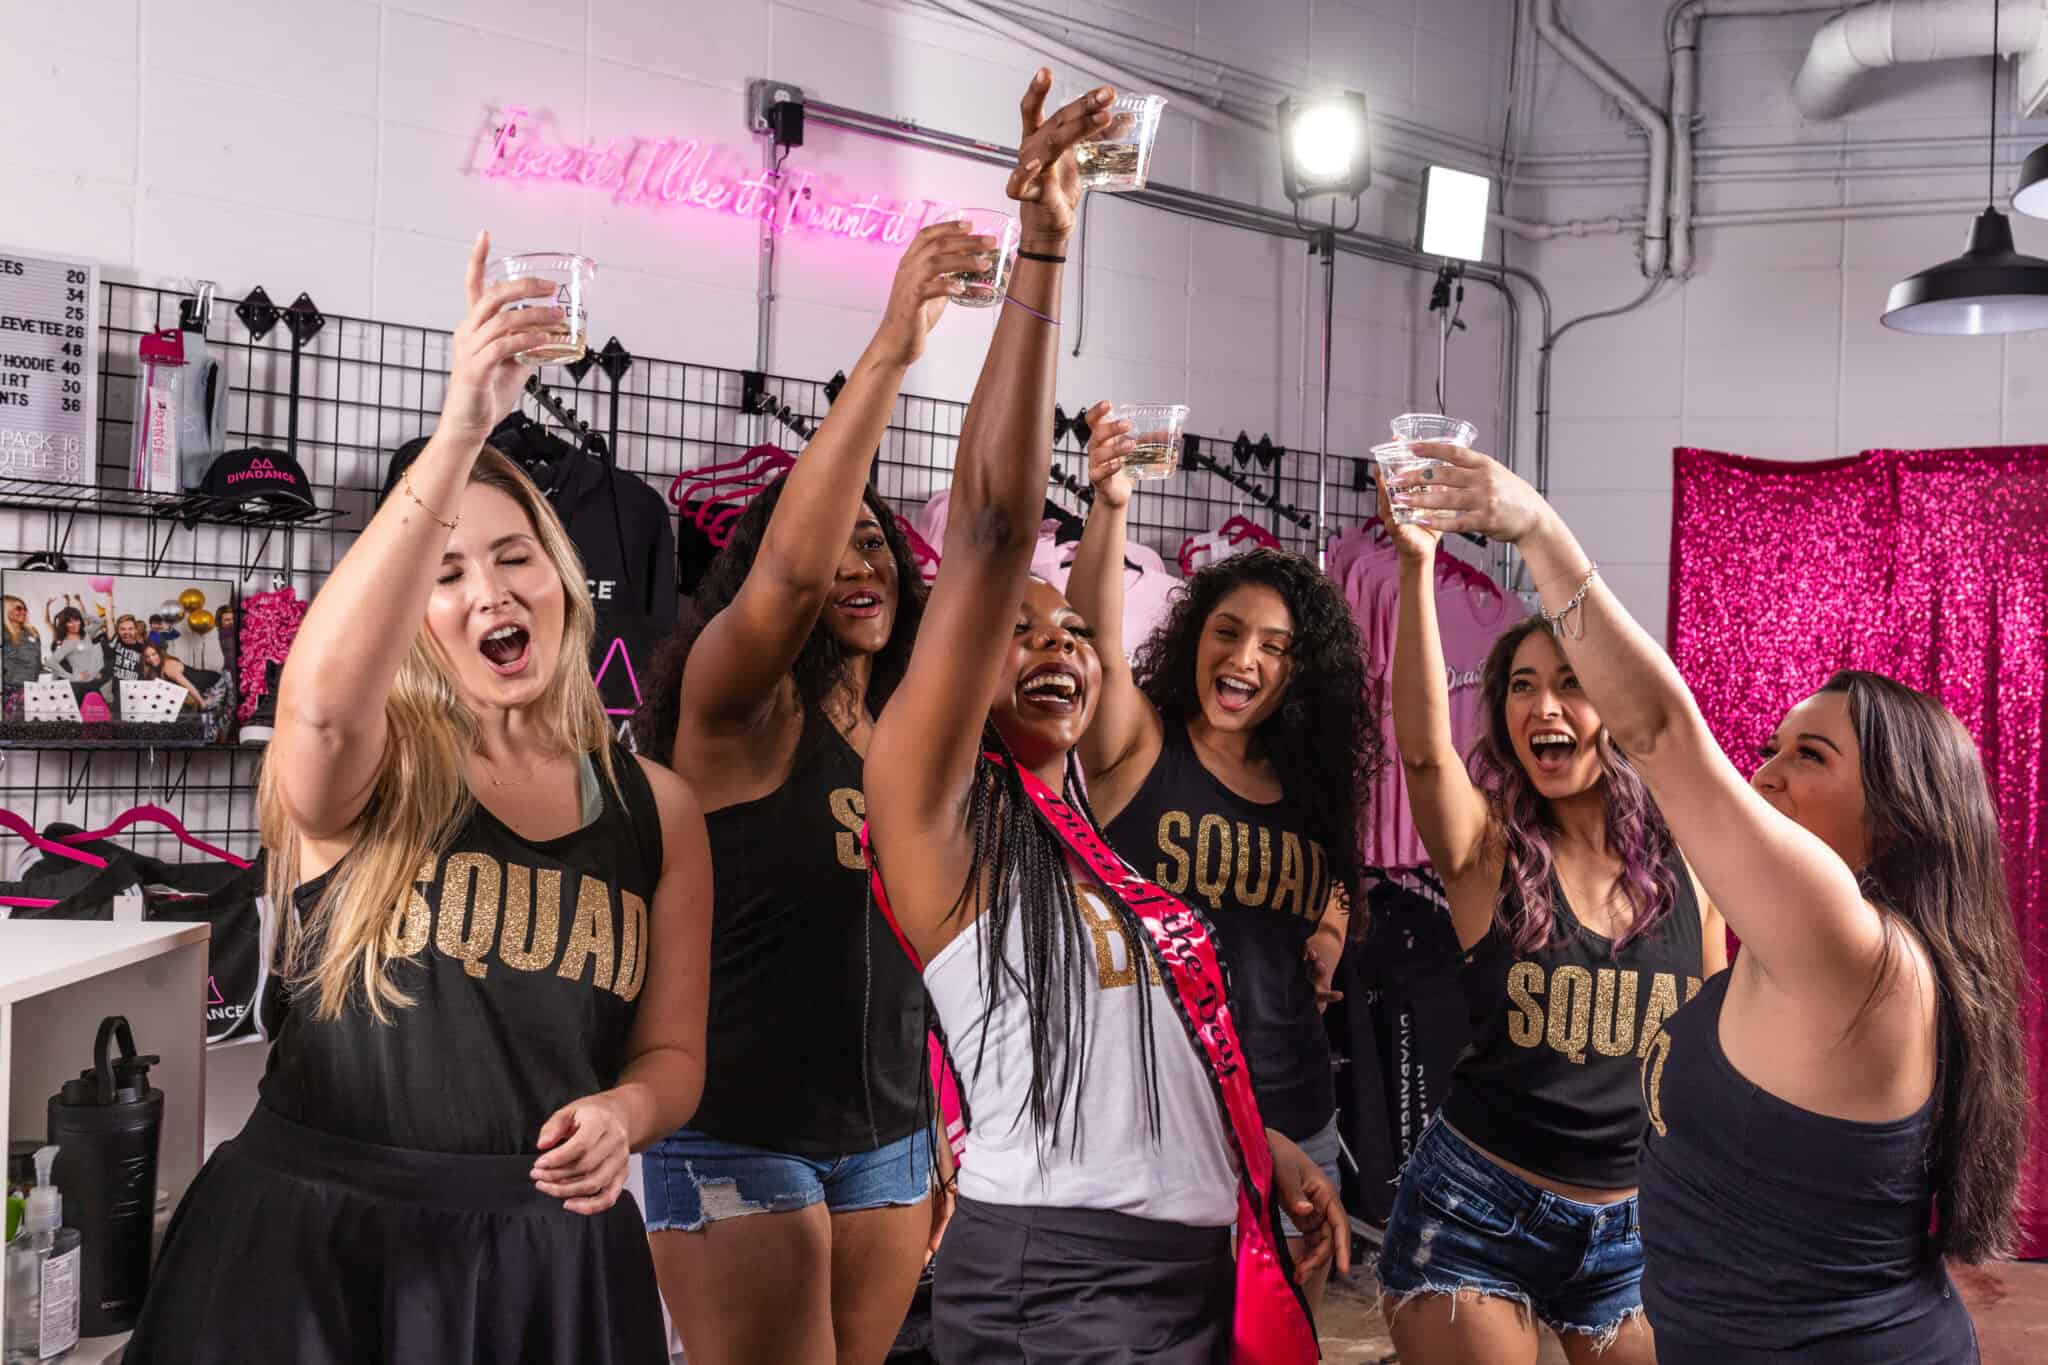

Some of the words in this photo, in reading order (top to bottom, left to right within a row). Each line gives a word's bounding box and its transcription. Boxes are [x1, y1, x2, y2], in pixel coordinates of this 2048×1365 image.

[661, 137, 731, 210] like
[808, 192, 884, 239] want
[66, 269, 86, 285] 20
[66, 287, 84, 303] 34
[65, 306, 84, 321] 25
[65, 324, 85, 339] 26
[61, 341, 82, 357] 48
[3, 353, 56, 373] HOODIE
[61, 360, 81, 376] 40
[62, 379, 81, 394] 30
[61, 397, 81, 412] 36
[227, 469, 297, 485] DIVADANCE
[1156, 810, 1329, 921] SQUAD
[384, 847, 648, 1002] SQUAD
[1161, 912, 1202, 974] the
[1197, 980, 1239, 1077] Day
[1507, 961, 1703, 1065] SQUA
